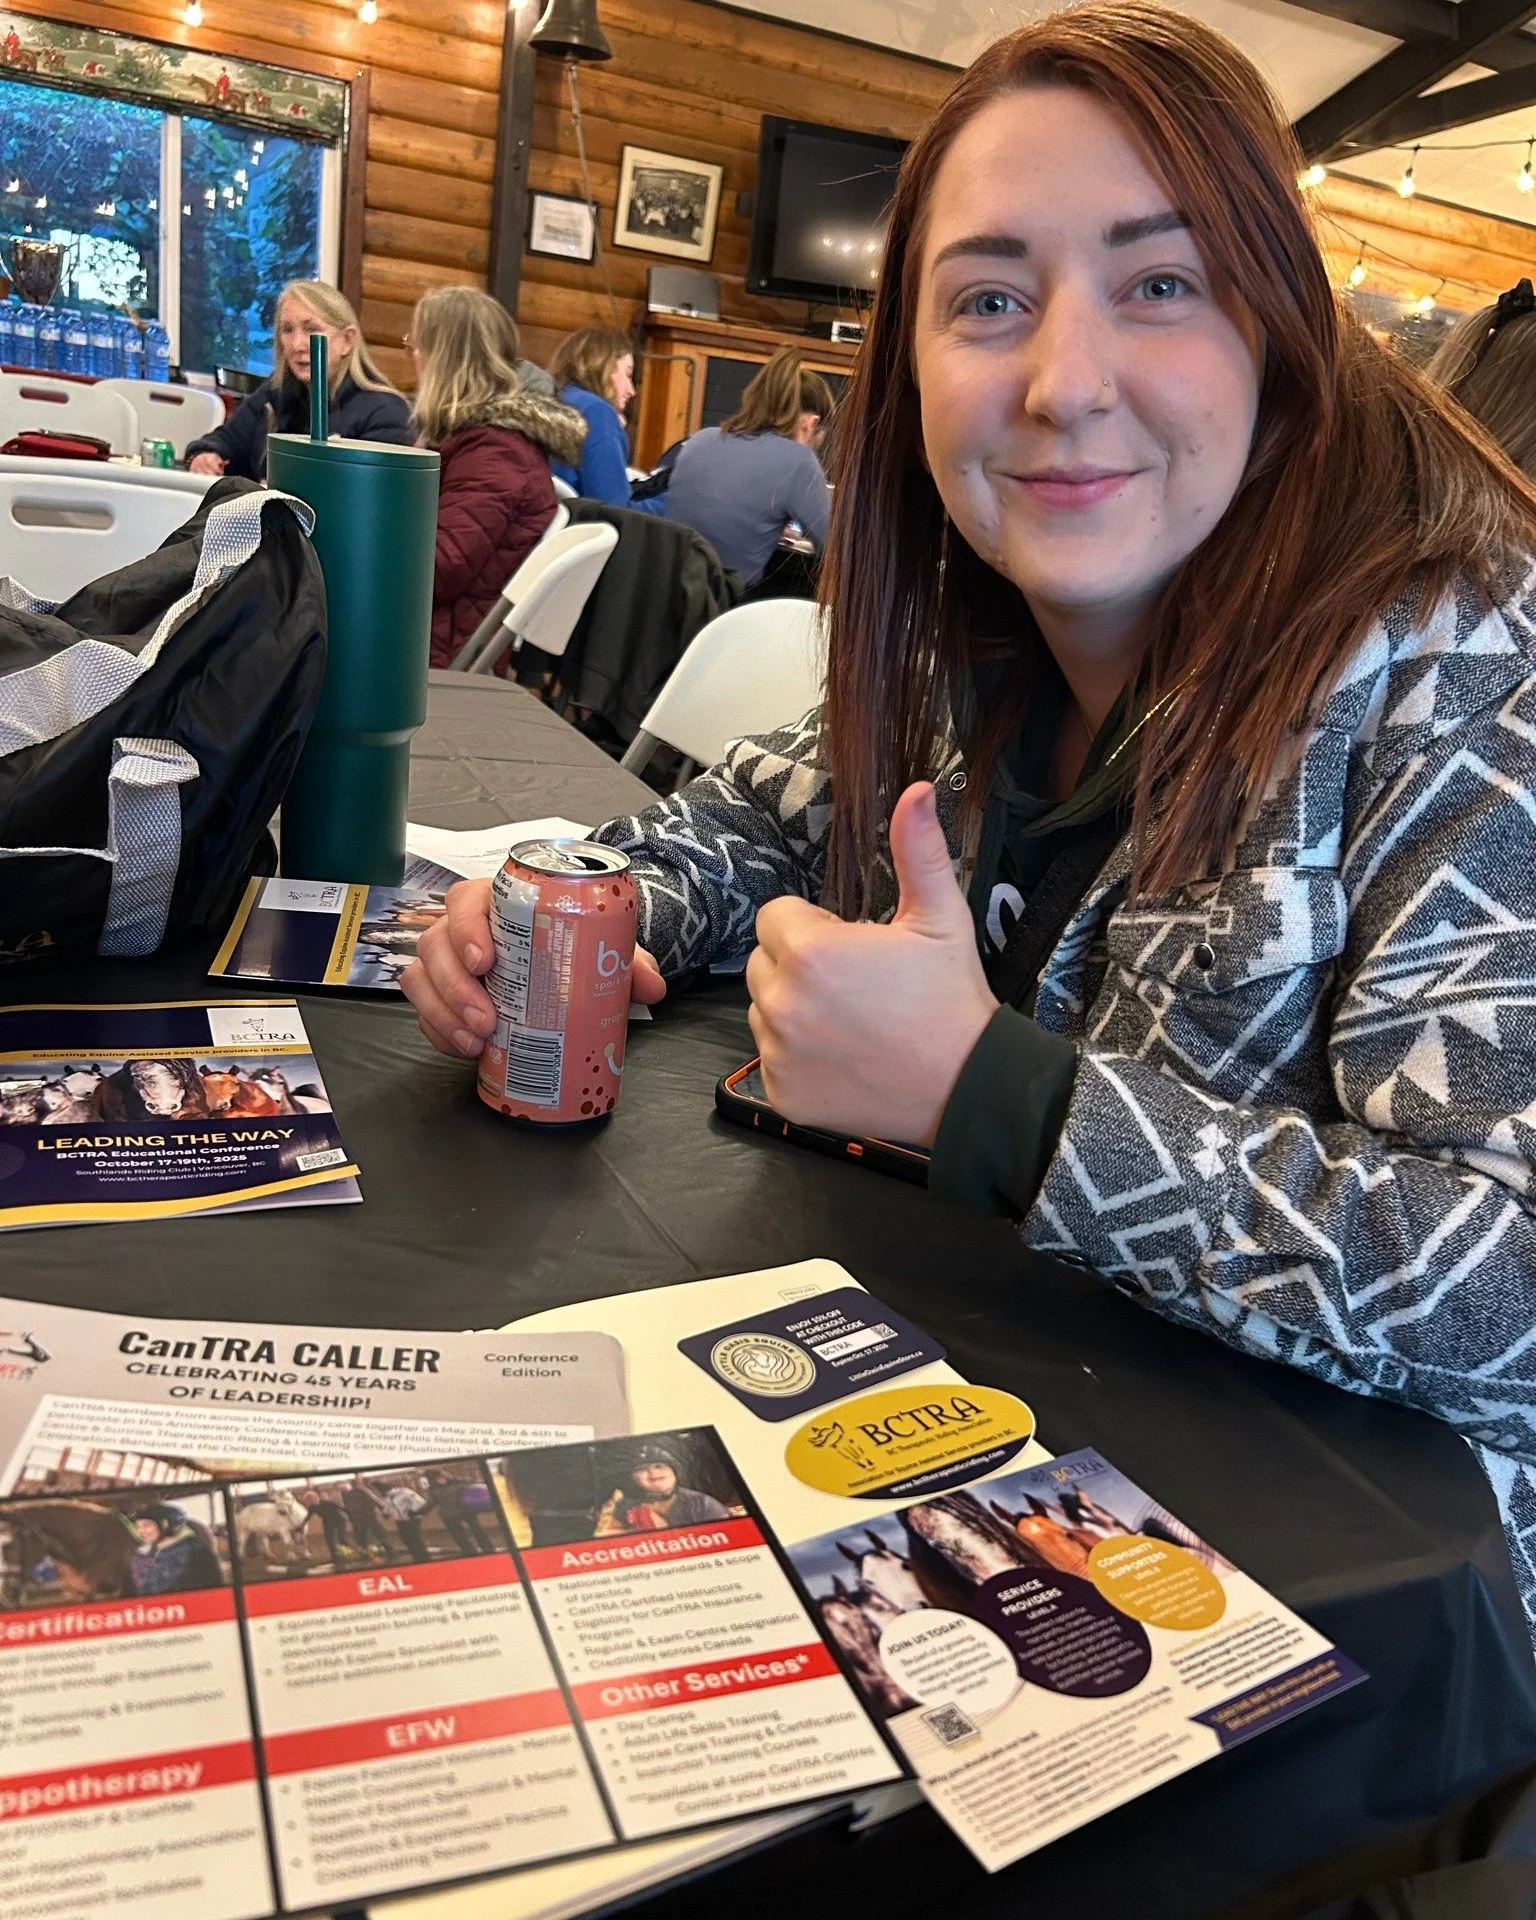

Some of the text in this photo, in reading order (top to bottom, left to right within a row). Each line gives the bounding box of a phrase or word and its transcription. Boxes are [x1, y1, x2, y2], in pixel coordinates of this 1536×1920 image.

[231, 1032, 296, 1041] BCTRA
[89, 1050, 171, 1058] Equine-Assisted
[554, 1045, 562, 1067] 00829
[551, 1070, 560, 1092] 69000
[37, 1128, 294, 1150] LEADING THE WAY
[57, 1144, 280, 1159] BCTRA Educational Conference
[76, 1168, 132, 1176] Southlands
[198, 1162, 251, 1171] Vancouver,
[94, 1154, 247, 1167] October 17-19th, 2025
[99, 1169, 247, 1182] www.bctherapeuticriding.com
[785, 1319, 812, 1332] ENJOY
[826, 1309, 842, 1318] OFF
[796, 1316, 847, 1339] AT CHECKOUT
[802, 1319, 866, 1345] WITH THIS CODE
[119, 1331, 441, 1374] CanTRA CALLER
[484, 1352, 579, 1362] Conference
[719, 1337, 796, 1375] LITTLE OASIS EQUINE
[820, 1341, 853, 1356] BCTRA
[126, 1362, 417, 1391] CELEBRATING 45 YEARS
[502, 1367, 562, 1377] Edition
[169, 1385, 371, 1409] OF LEADERSHIP!
[52, 1401, 105, 1411] CanTRA
[108, 1406, 171, 1417] members
[210, 1414, 249, 1422] across
[253, 1416, 274, 1424] the
[277, 1418, 324, 1427] country
[366, 1423, 419, 1432] together
[441, 1426, 466, 1435] May
[498, 1428, 517, 1436] 3rd
[139, 1418, 162, 1426] this
[165, 1420, 241, 1432] Anniversary
[405, 1434, 430, 1442] Hills
[434, 1436, 478, 1445] Retreat
[856, 1396, 984, 1446] BCTRA
[886, 1417, 993, 1456] BC Therapeutic Riding Association
[890, 1449, 1006, 1494] www.bctherapeuticriding.com
[1051, 1457, 1104, 1484] BCTRA
[562, 1531, 729, 1568] Accreditation
[1096, 1541, 1153, 1569] COMMUNITY
[558, 1553, 761, 1590] National safety standards & scope
[1106, 1551, 1168, 1579] SUPPORTERS
[358, 1574, 413, 1596] EAL
[566, 1587, 632, 1602] of practice
[997, 1578, 1044, 1602] SERVICE
[569, 1582, 742, 1617] CanTRA Certified Instructors
[574, 1591, 763, 1629] Eligibility for CanTRA Insurance
[1001, 1587, 1064, 1617] PROVIDERS
[579, 1627, 635, 1641] Program
[584, 1612, 799, 1656] Regular & Exam Centre designation
[887, 1618, 967, 1655] JOIN US TODAY!
[589, 1635, 752, 1669] Credibility across Canada
[600, 1679, 681, 1706] Other
[386, 1715, 455, 1748] EFW
